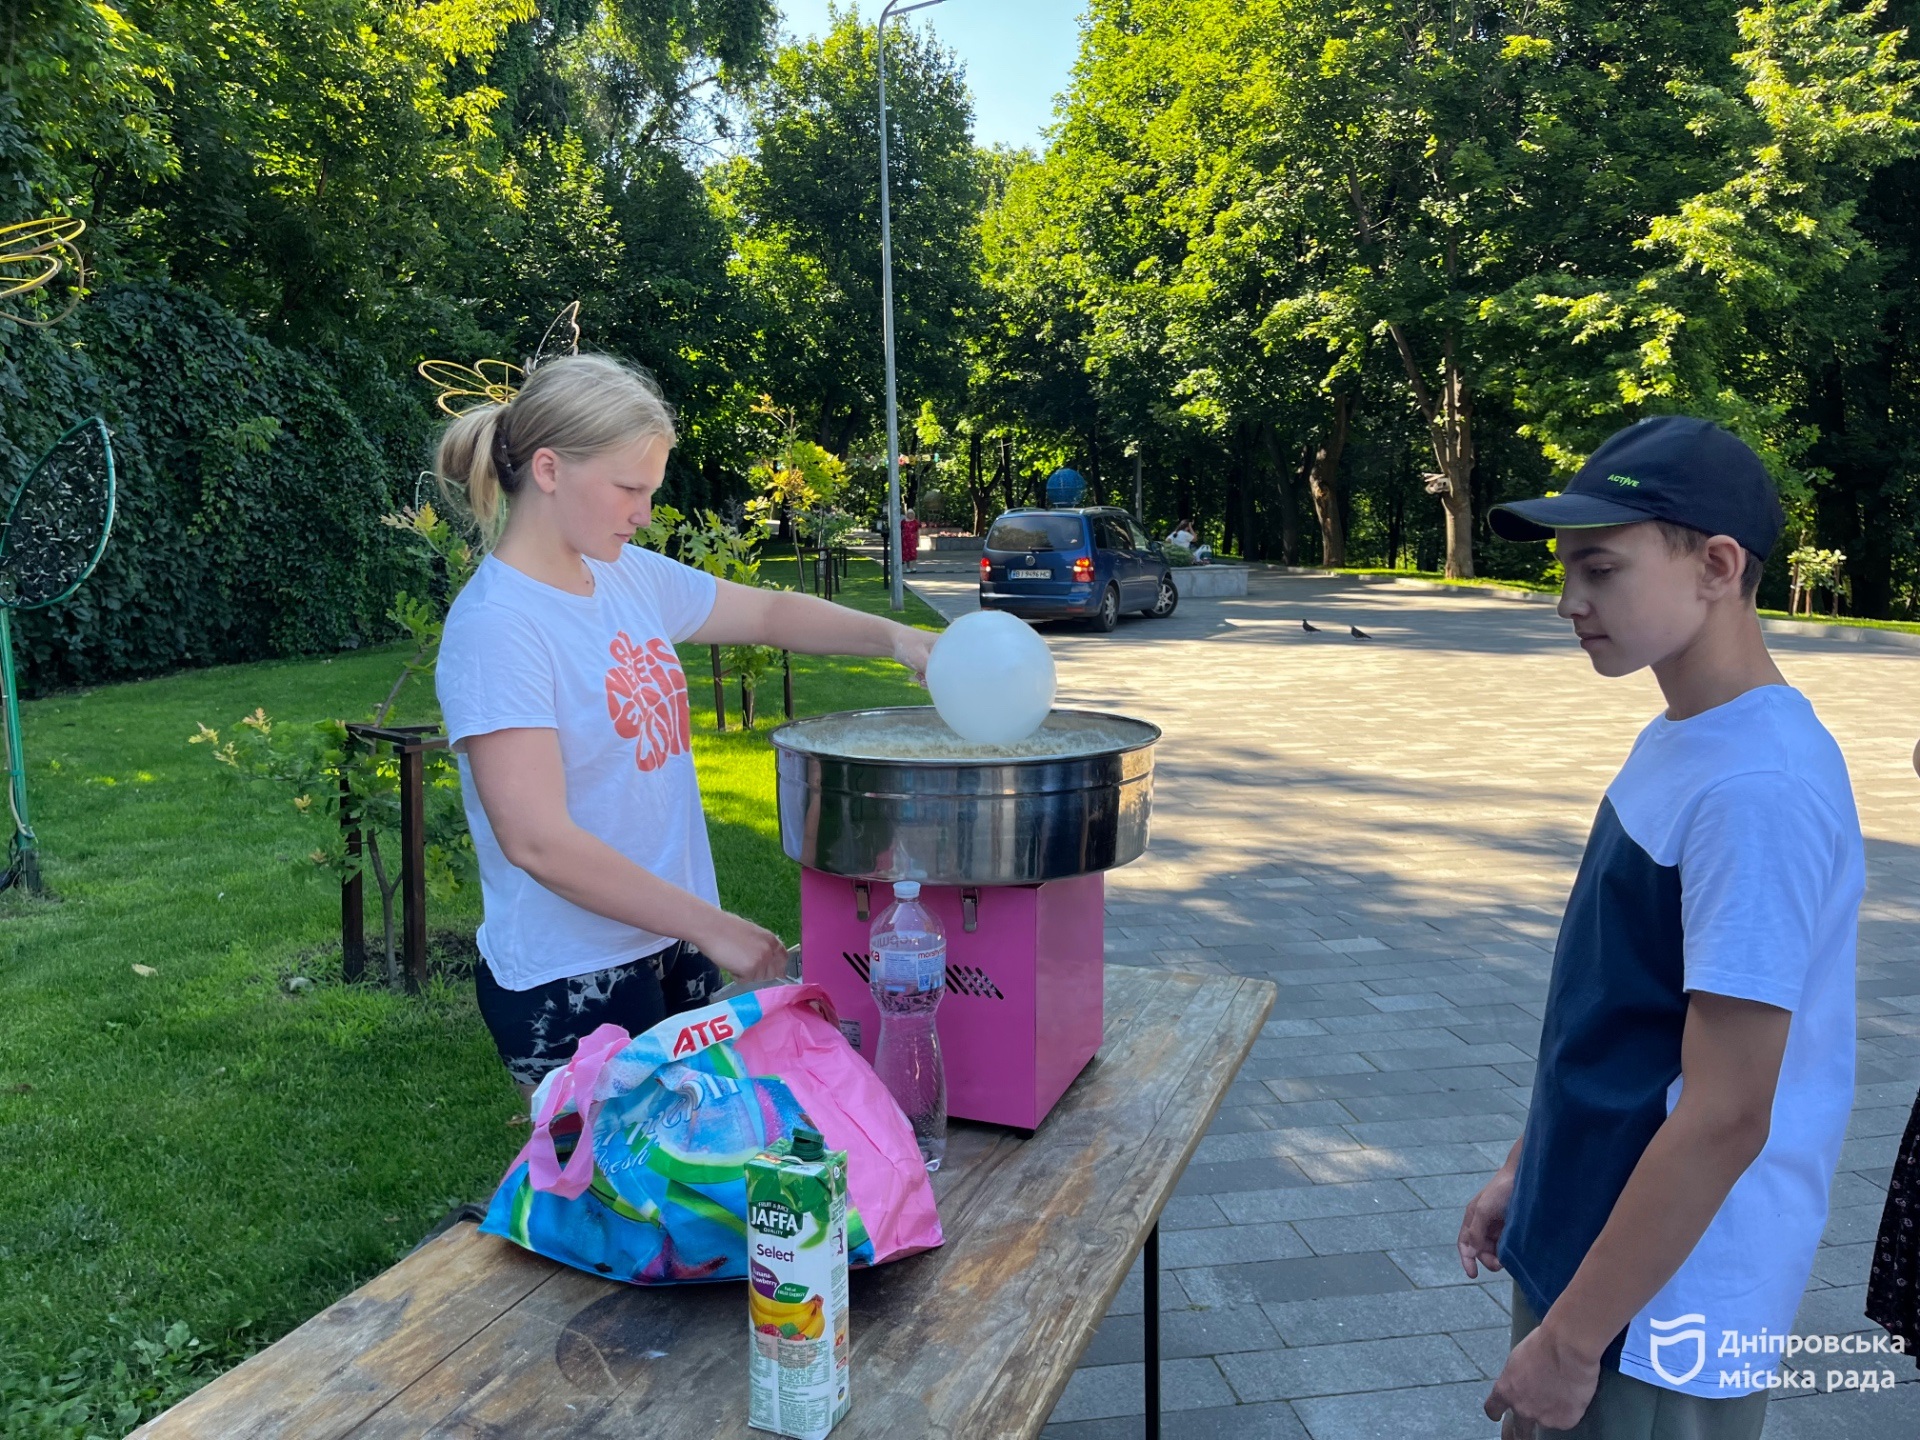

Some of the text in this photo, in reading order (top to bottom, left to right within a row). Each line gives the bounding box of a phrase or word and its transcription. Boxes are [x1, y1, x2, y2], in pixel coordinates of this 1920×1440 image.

[1607, 474, 1640, 487] ACTIVE
[673, 1014, 734, 1059] АТБ
[751, 1206, 798, 1233] JAFFA
[763, 1227, 783, 1236] QUALITY
[757, 1244, 795, 1262] Select
